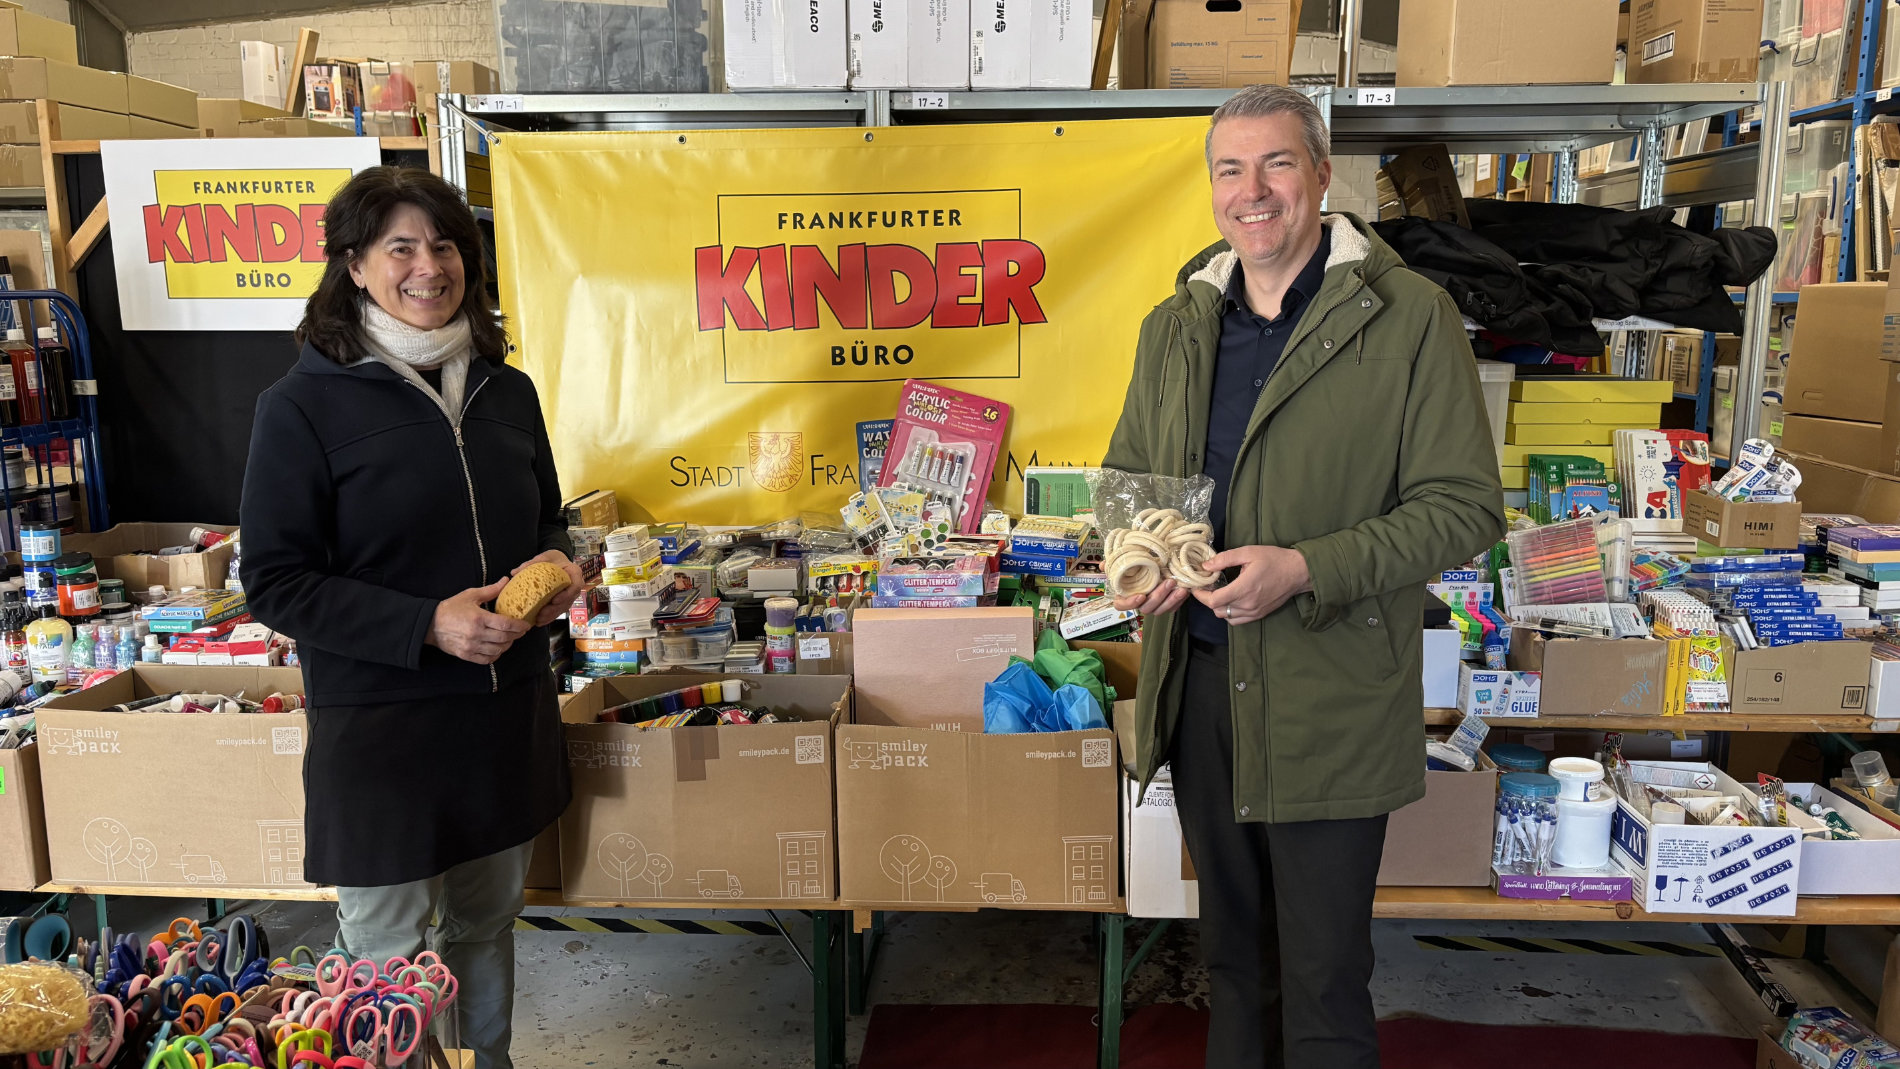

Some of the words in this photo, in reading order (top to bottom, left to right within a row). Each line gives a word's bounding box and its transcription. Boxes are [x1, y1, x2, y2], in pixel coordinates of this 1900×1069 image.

[193, 180, 316, 195] FRANKFURTER
[777, 209, 962, 230] FRANKFURTER
[143, 202, 328, 265] KINDE
[236, 269, 291, 288] BÜRO
[695, 239, 1048, 332] KINDER
[831, 340, 915, 365] BÜRO
[908, 390, 951, 410] ACRYLIC
[905, 404, 949, 425] COLOUR
[983, 407, 998, 420] 16
[863, 430, 892, 443] WAT
[862, 447, 886, 459] COL
[1744, 522, 1774, 531] HIMI
[904, 578, 927, 587] GLITTER
[929, 577, 957, 587] TEMPERA
[1443, 572, 1476, 581] DOMS
[1774, 672, 1783, 682] 6
[1511, 701, 1538, 713] GLUE
[76, 728, 119, 741] smiley
[79, 740, 121, 755] pack
[216, 737, 267, 747] smileypack.de
[597, 740, 641, 755] smiley
[881, 740, 928, 755] smiley
[739, 747, 790, 758] smileypack.de
[1025, 750, 1077, 761] smileypack.de
[598, 754, 642, 769] pack
[882, 755, 929, 770] pack
[1142, 797, 1172, 807] ATALOGO
